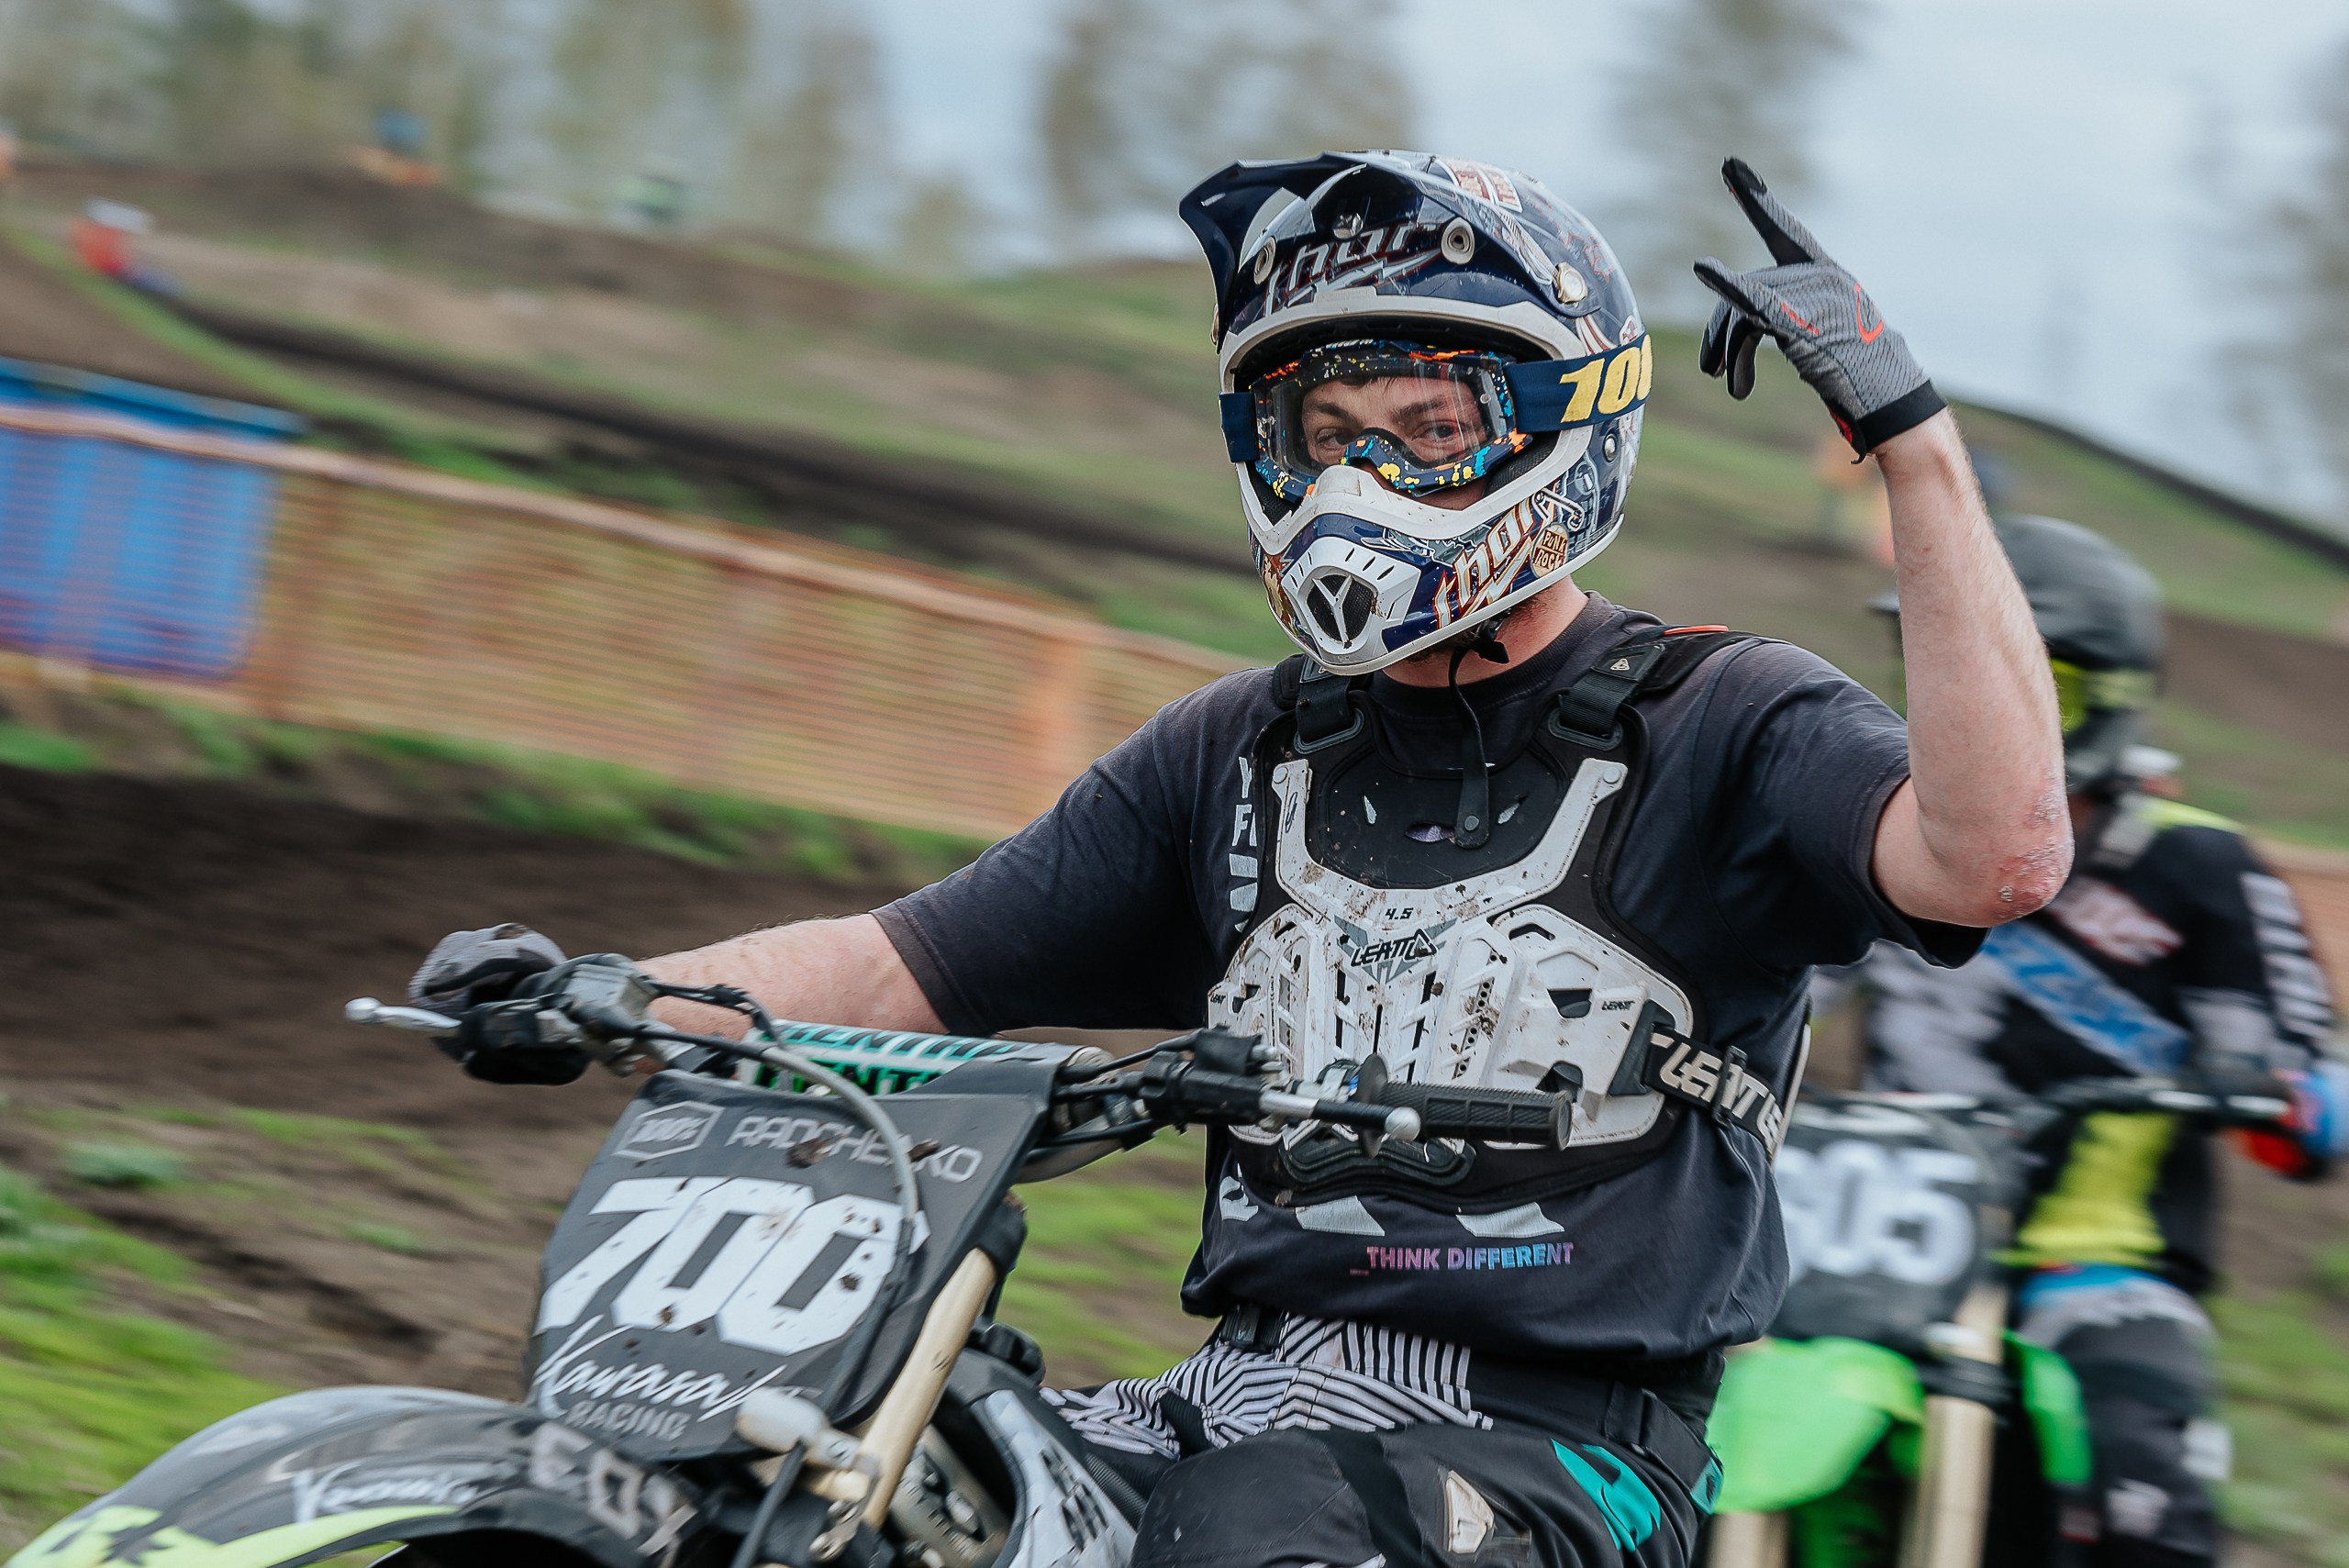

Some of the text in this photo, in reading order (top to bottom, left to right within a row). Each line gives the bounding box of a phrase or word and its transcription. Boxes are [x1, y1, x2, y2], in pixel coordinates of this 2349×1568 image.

[1385, 906, 1414, 920] 4.5
[532, 1175, 930, 1356] 700
[1447, 1241, 1574, 1271] DIFFERENT
